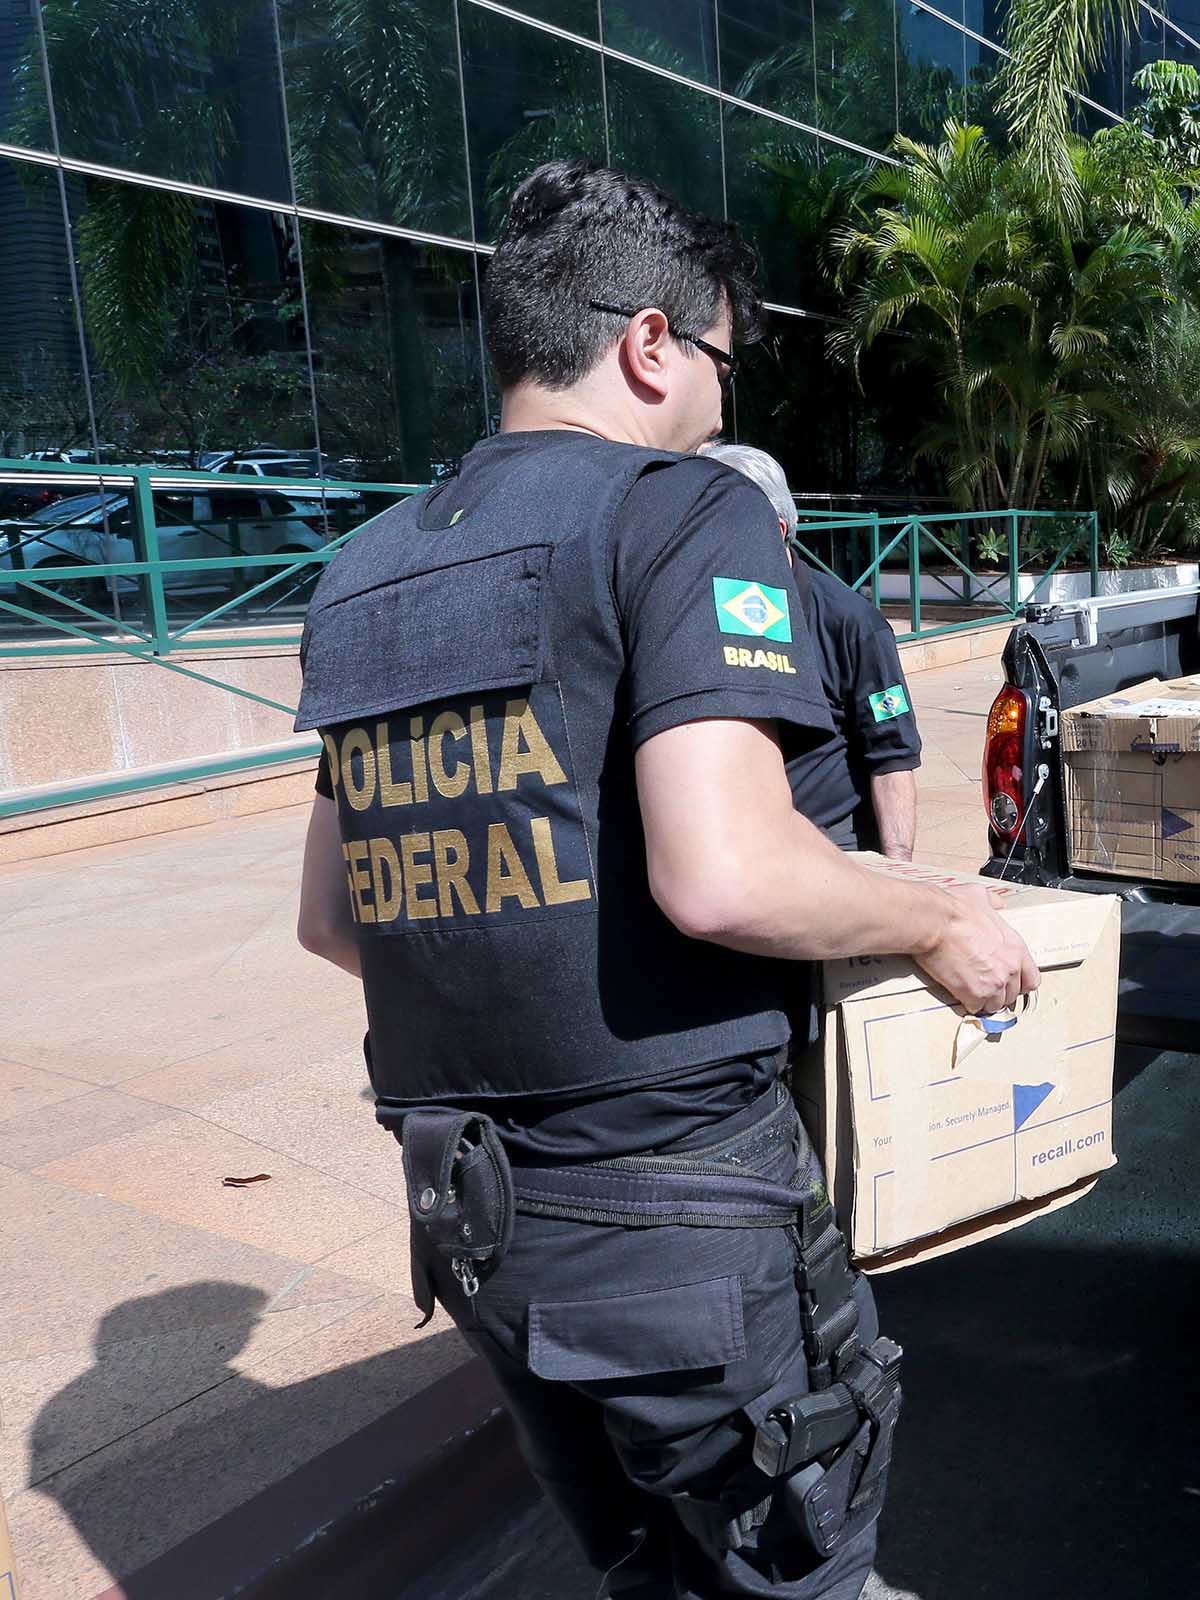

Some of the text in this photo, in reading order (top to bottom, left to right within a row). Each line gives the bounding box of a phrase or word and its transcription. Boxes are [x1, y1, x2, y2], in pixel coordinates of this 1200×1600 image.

[723, 646, 797, 675] BRASIL
[342, 816, 592, 925] FEDERAL
[872, 1135, 893, 1148] Your
[945, 1110, 976, 1127] Securely
[1031, 1130, 1105, 1167] recall.com
